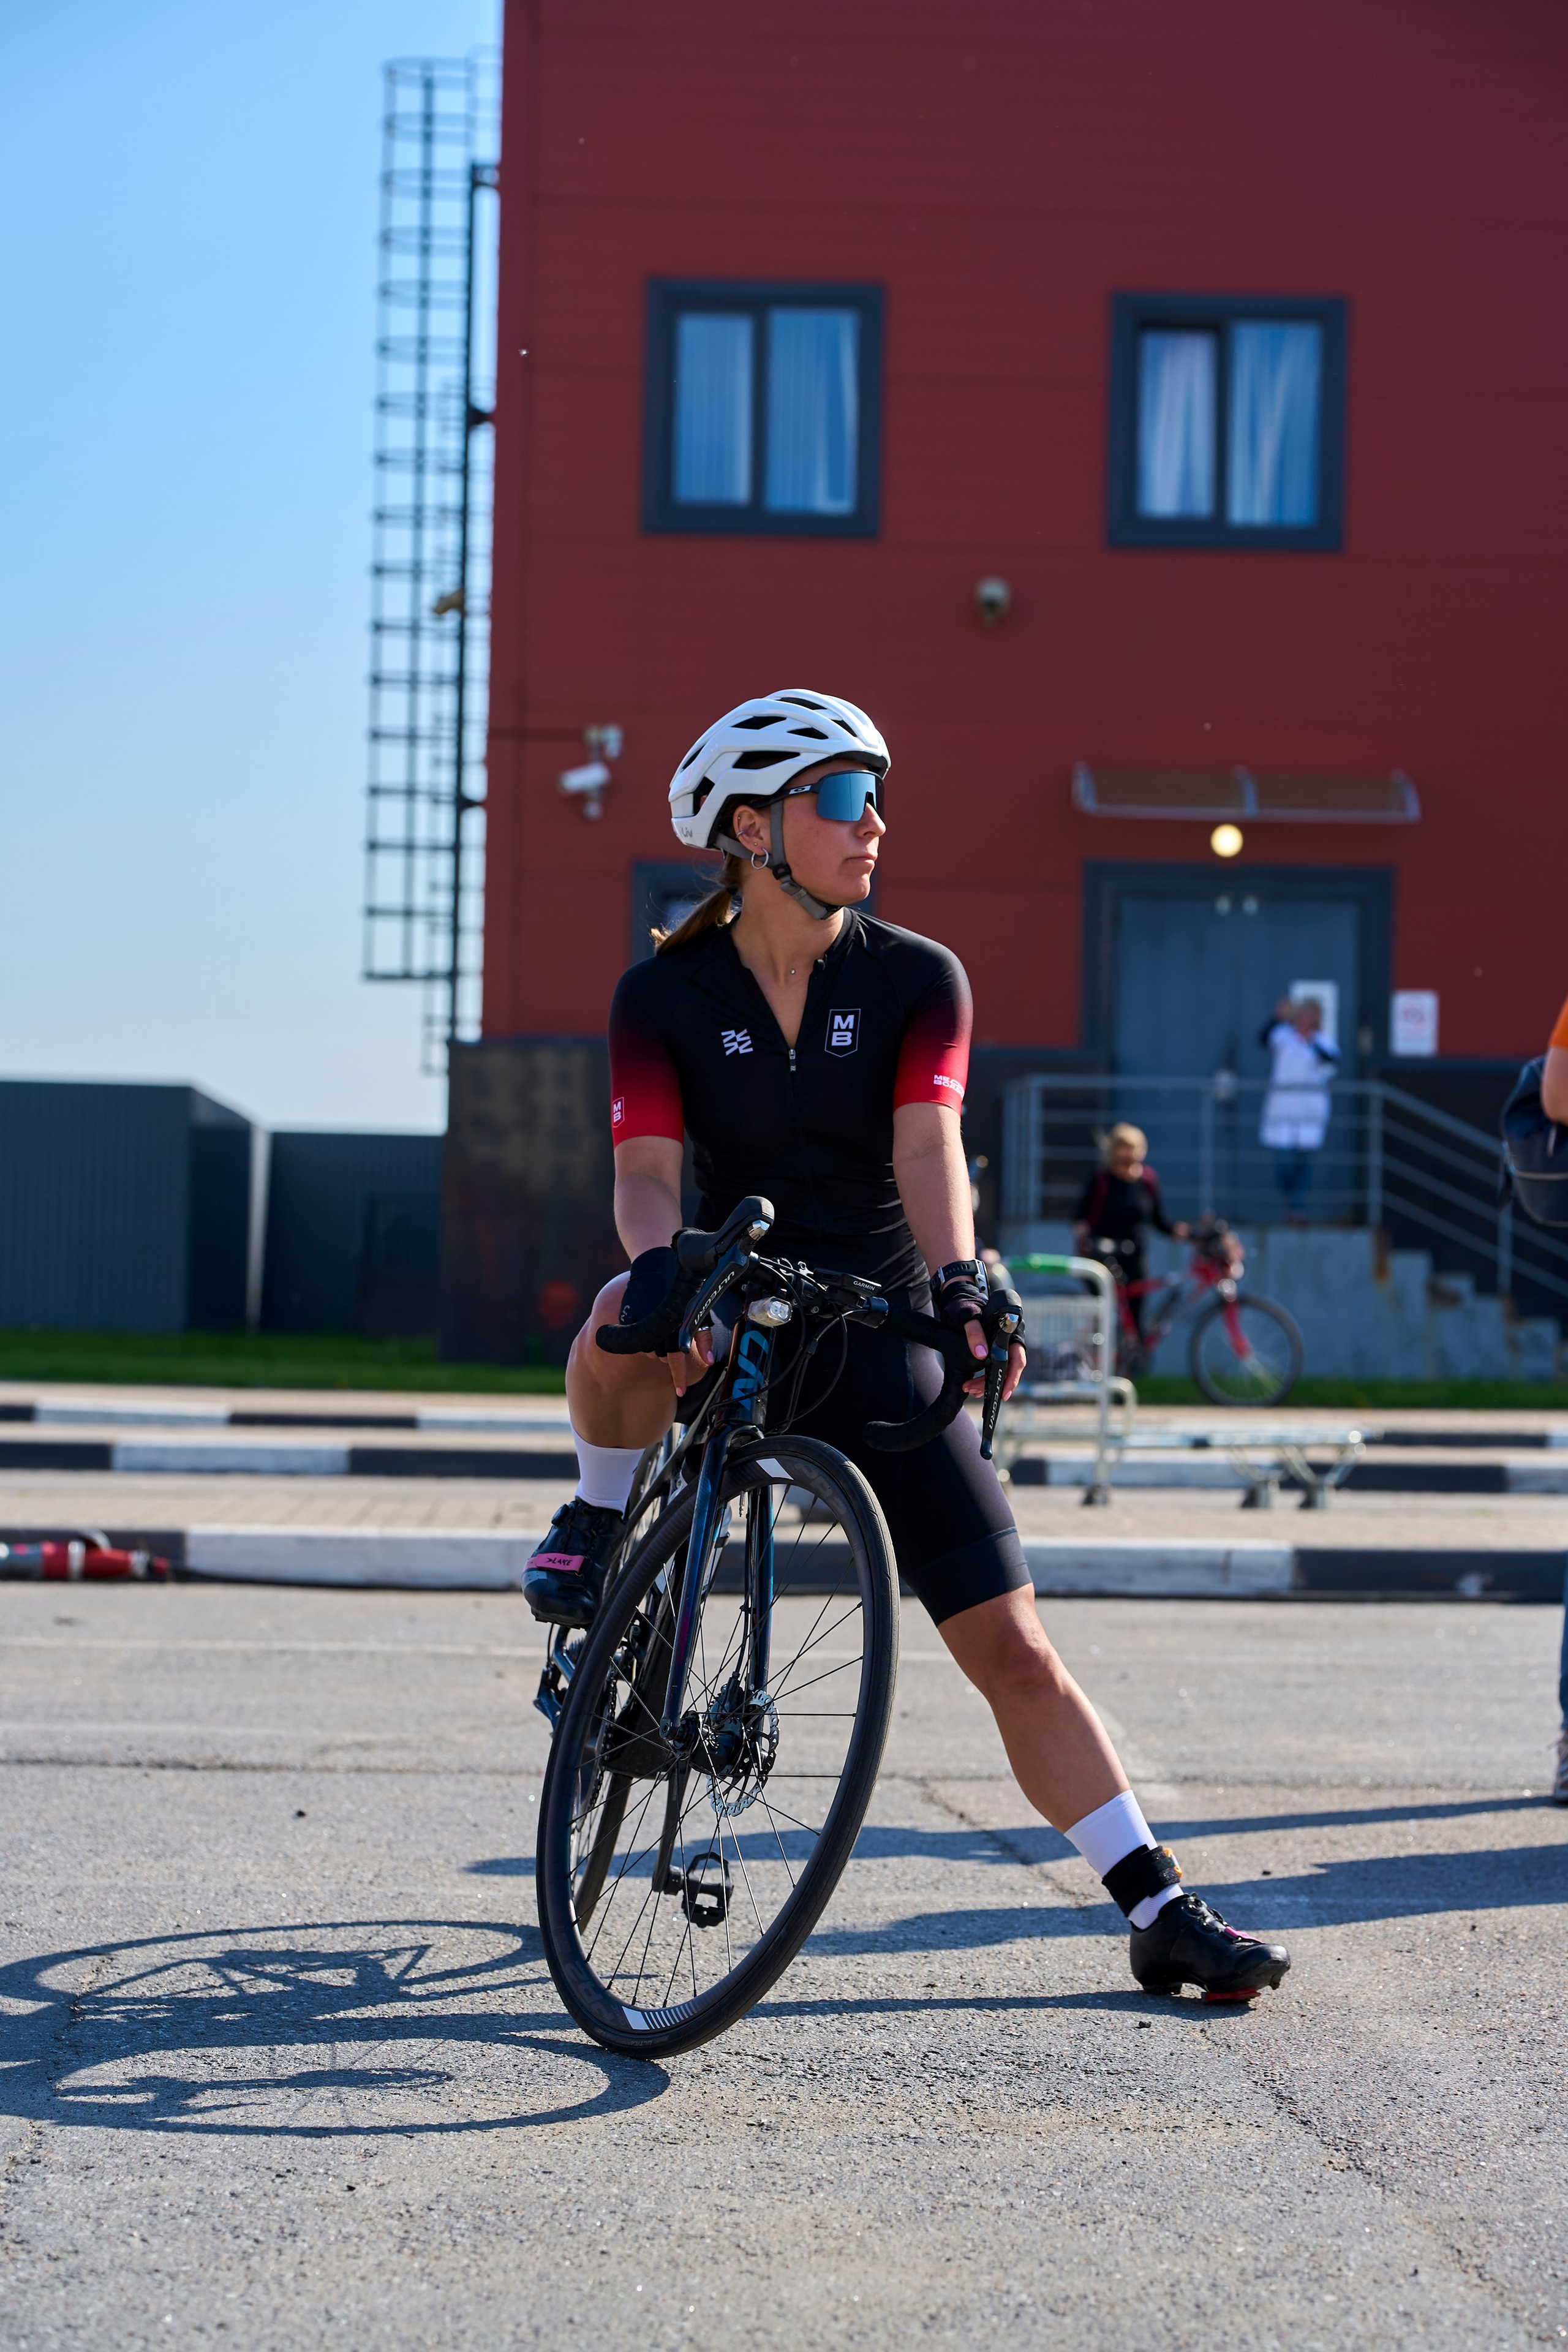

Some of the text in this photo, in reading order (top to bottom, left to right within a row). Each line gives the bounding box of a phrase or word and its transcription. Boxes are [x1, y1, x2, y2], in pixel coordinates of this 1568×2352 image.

[694, 1271, 734, 1325] ULTEGRA
[853, 1281, 875, 1291] GARMIN
[989, 1368, 1002, 1430] ULTEGRA
